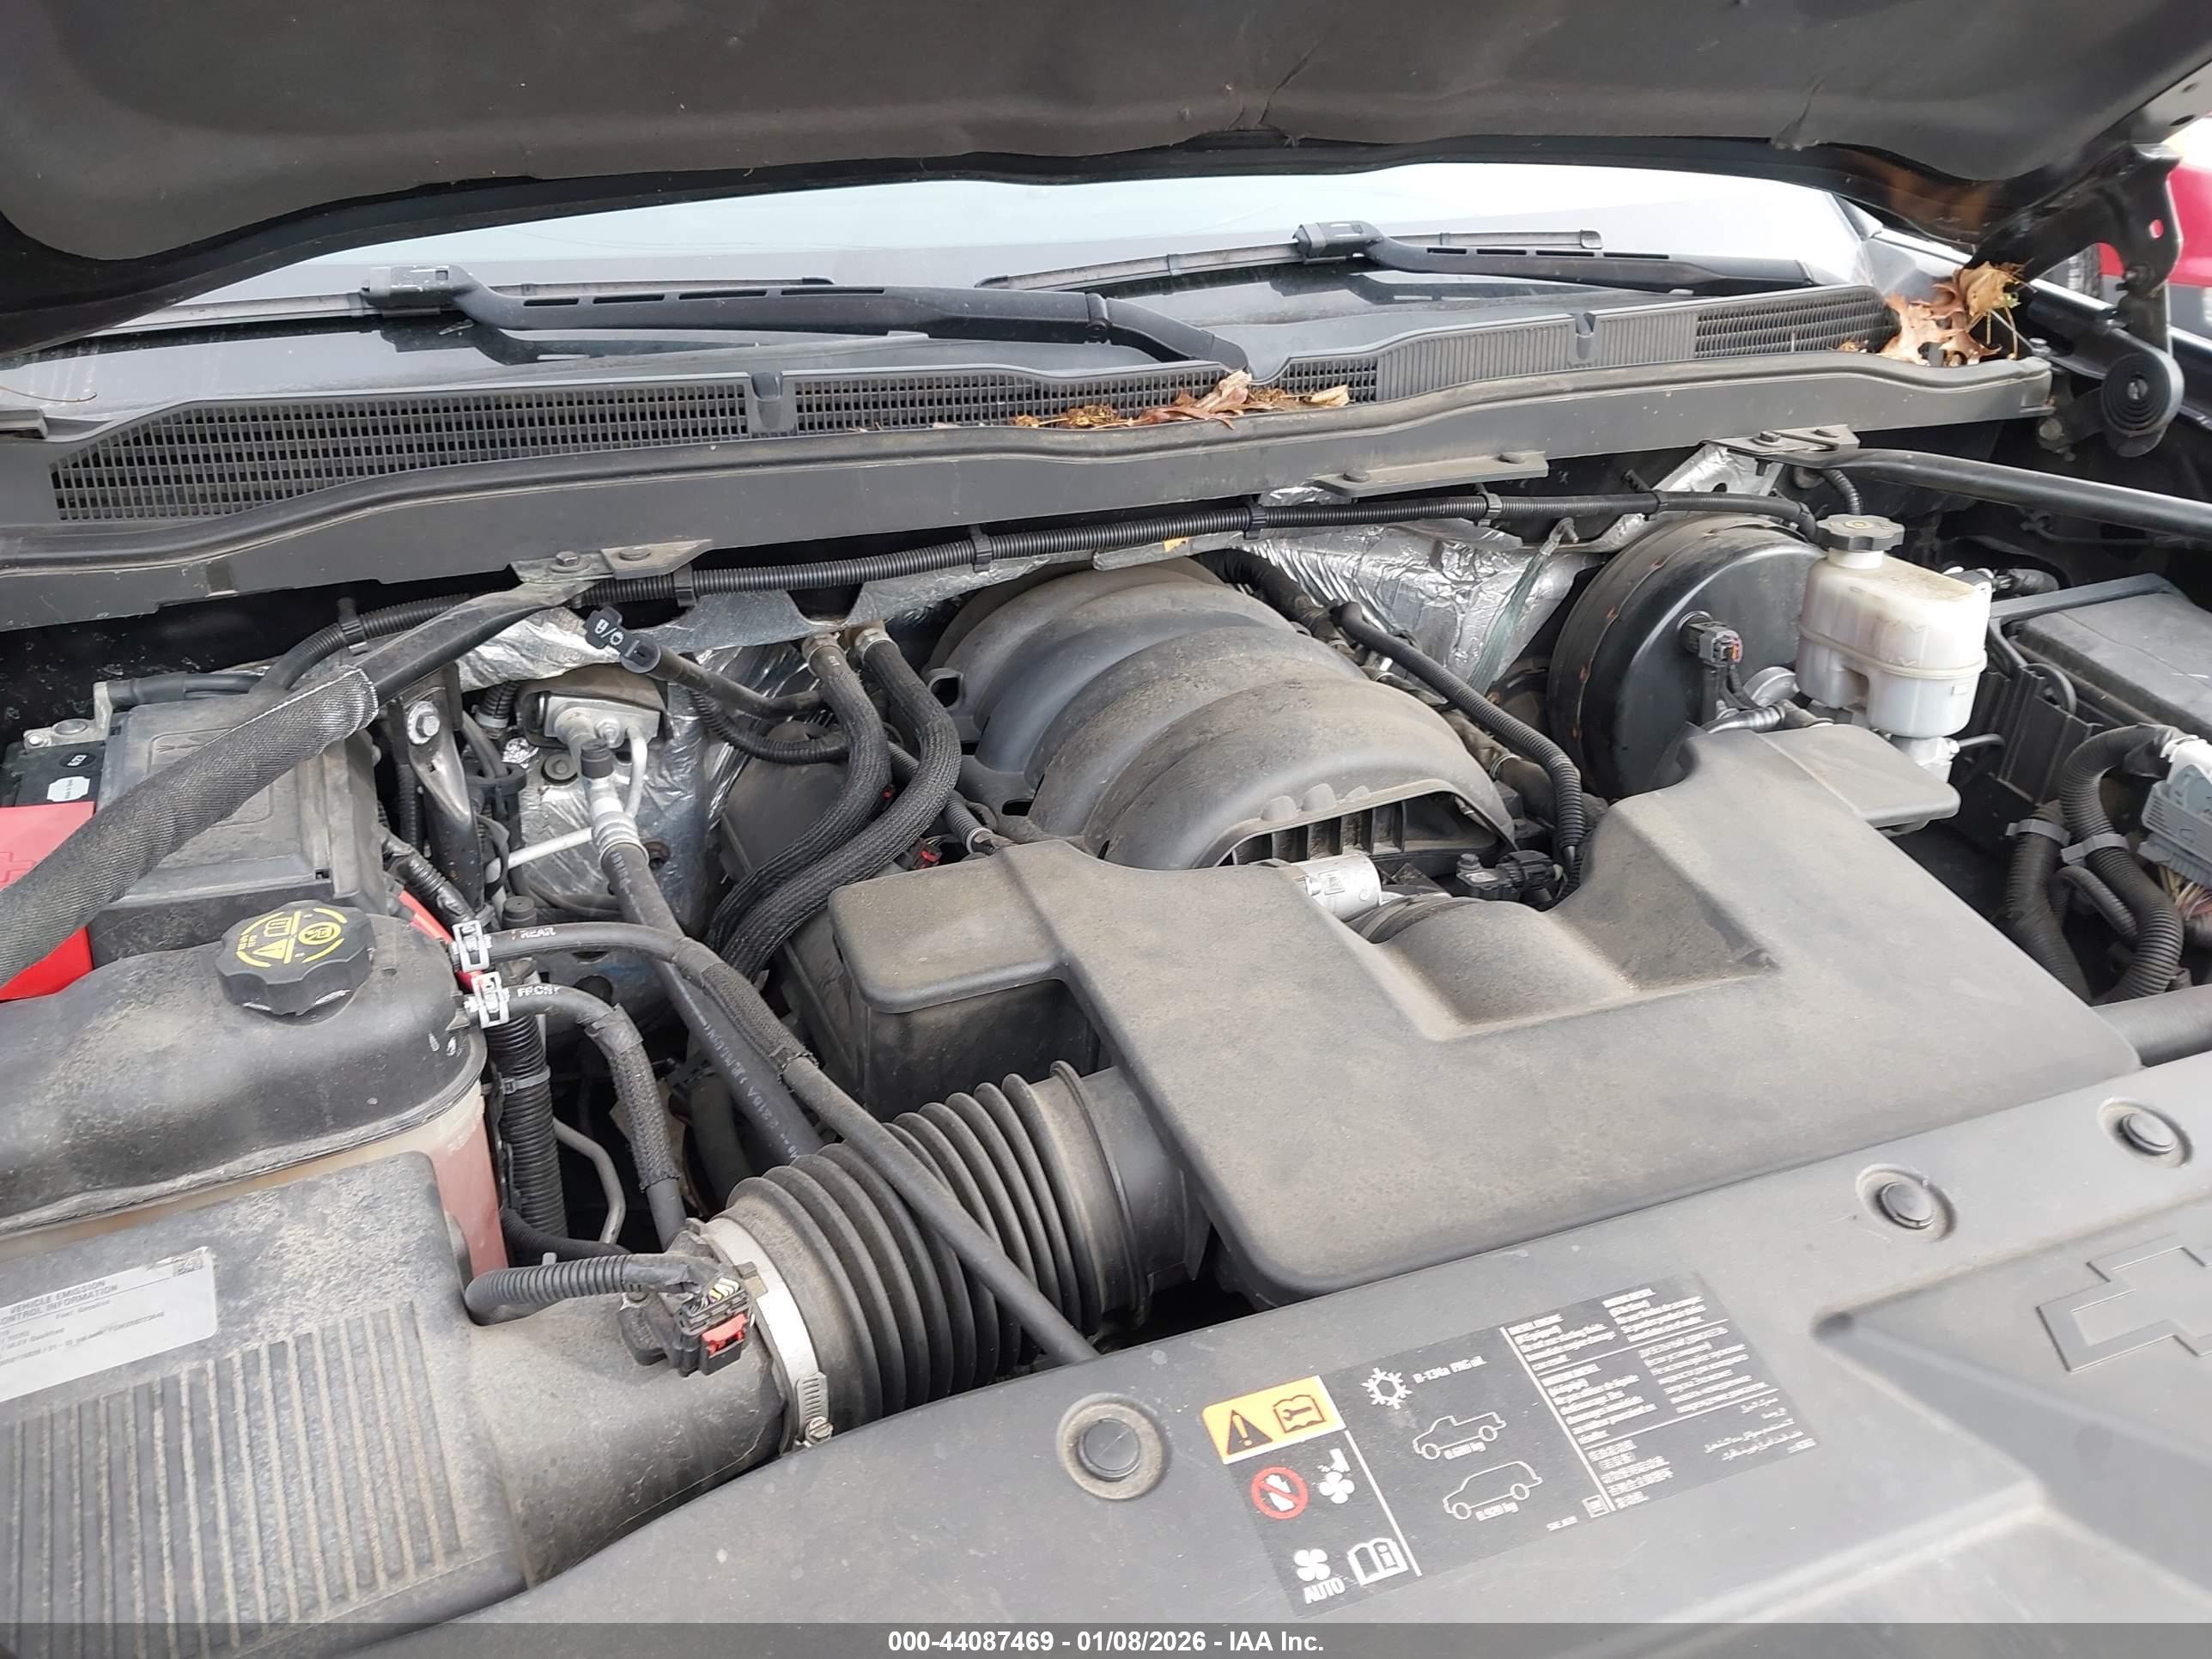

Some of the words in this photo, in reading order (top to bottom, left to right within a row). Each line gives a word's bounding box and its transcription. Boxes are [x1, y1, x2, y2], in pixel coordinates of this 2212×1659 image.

[10, 1295, 52, 1314] VEHICLE
[55, 1280, 106, 1301] EMISSION
[46, 1285, 118, 1312] INFORMATION
[1304, 1577, 1346, 1605] AUTO
